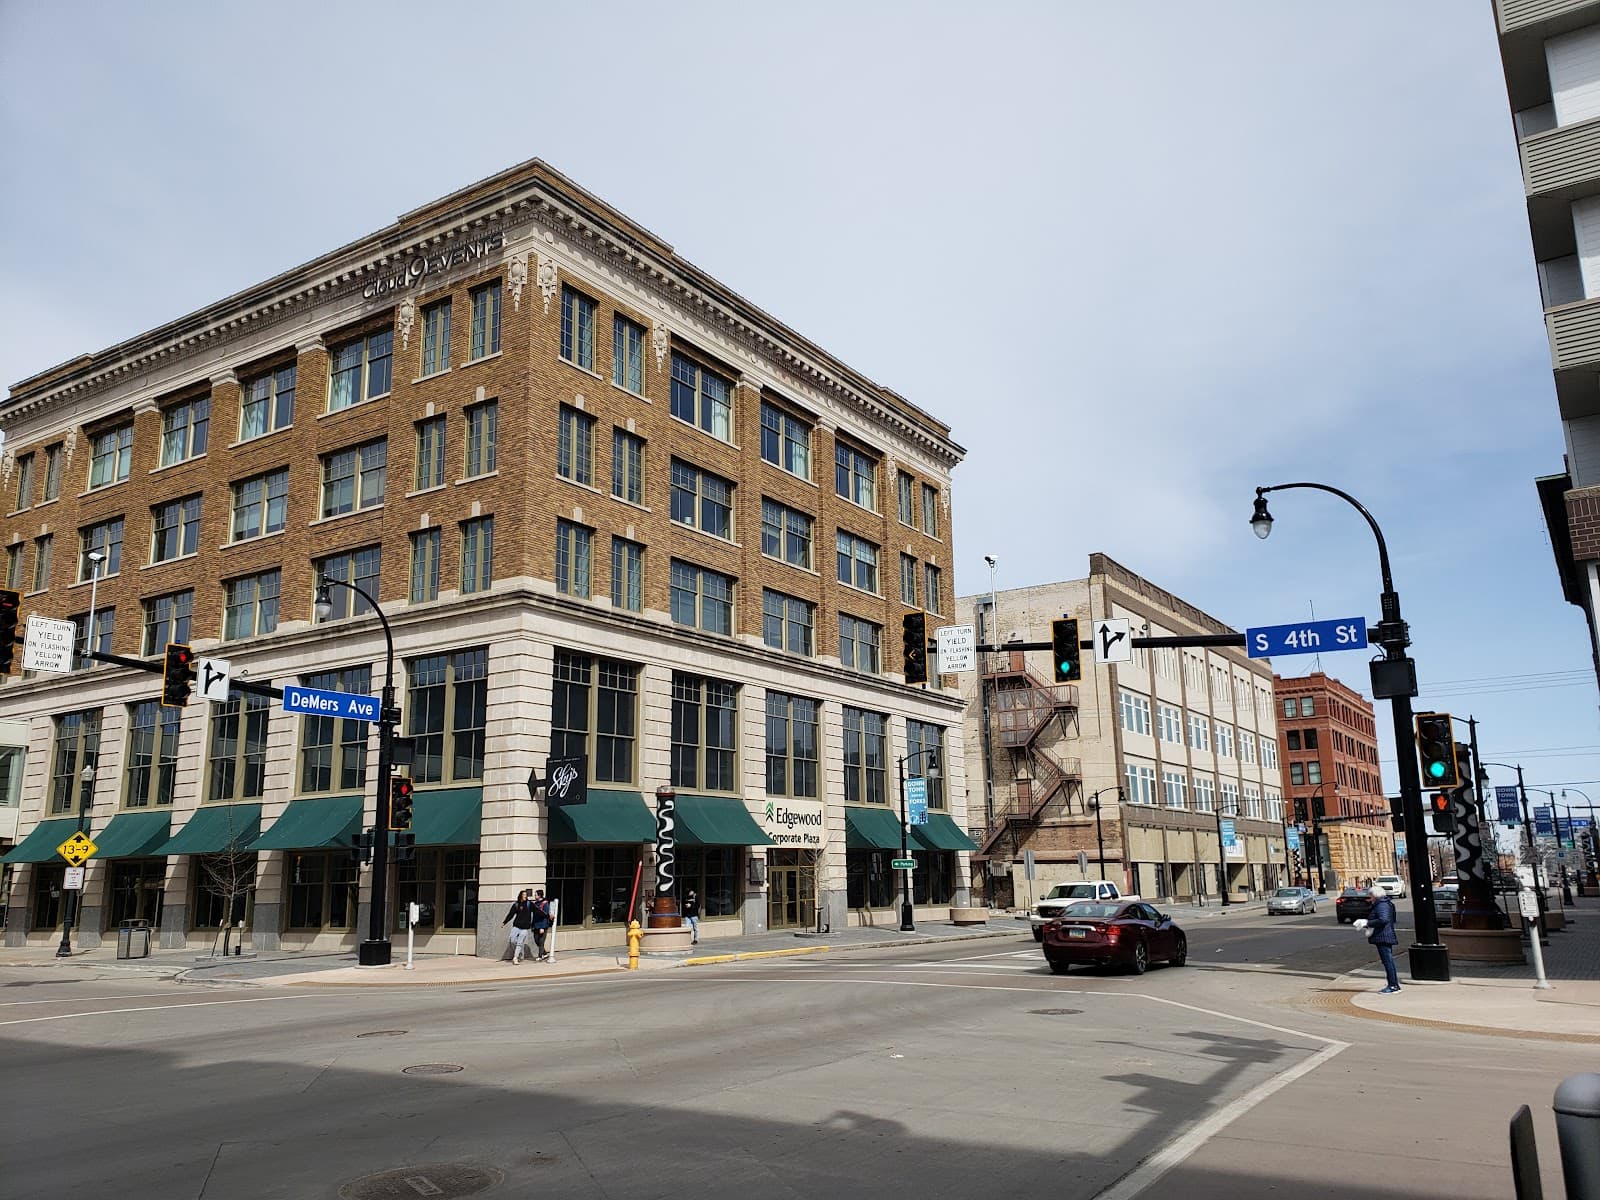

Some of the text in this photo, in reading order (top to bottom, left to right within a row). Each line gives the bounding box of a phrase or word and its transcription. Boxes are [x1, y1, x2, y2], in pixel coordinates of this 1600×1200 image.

[31, 620, 71, 632] LEFT TURN
[38, 631, 63, 641] YIELD
[946, 637, 967, 645] YIELD
[1255, 624, 1358, 651] S 4th St
[40, 642, 70, 652] FLASHING
[34, 650, 62, 660] YELLOW
[34, 659, 60, 668] ARROW
[290, 692, 374, 716] DeMers Ave
[776, 807, 822, 830] Edgewood
[803, 833, 820, 844] Plaza
